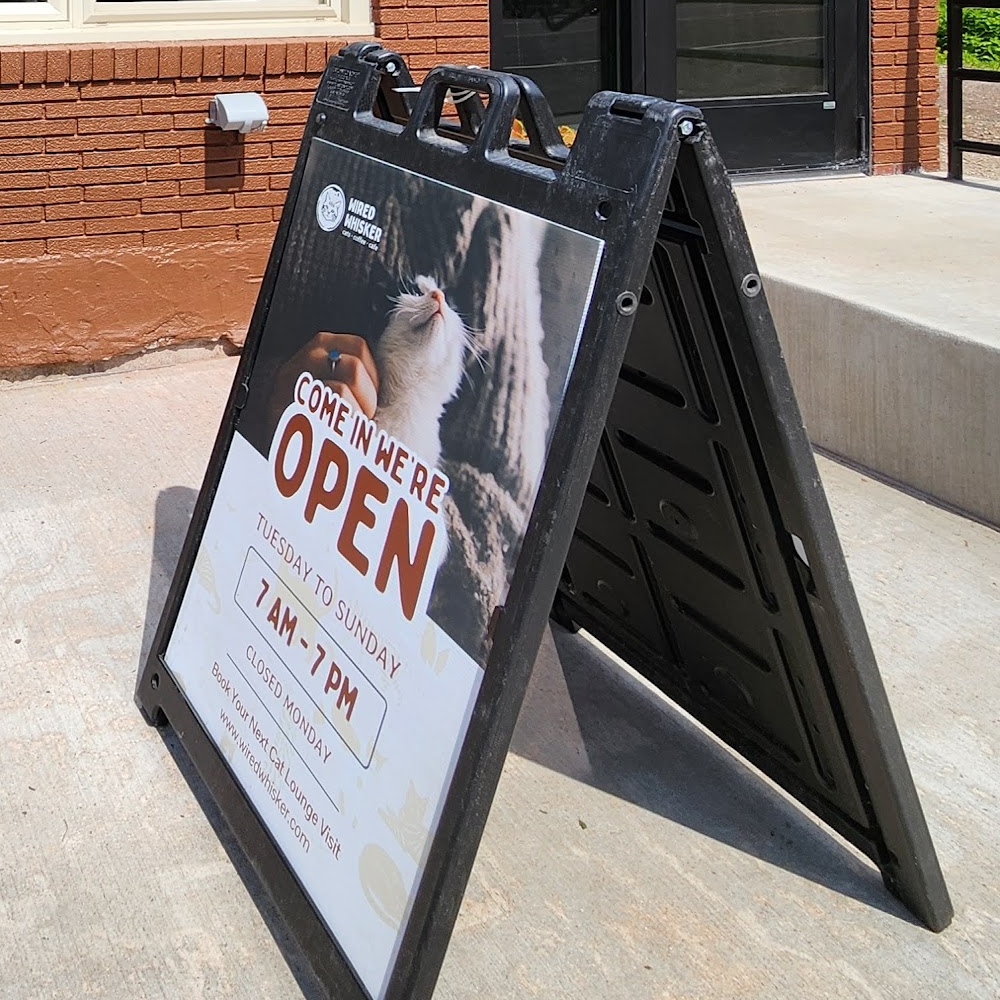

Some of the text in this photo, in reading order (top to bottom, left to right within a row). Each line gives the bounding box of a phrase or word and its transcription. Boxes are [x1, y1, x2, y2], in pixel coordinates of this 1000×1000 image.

[344, 214, 382, 242] WHISKER
[348, 198, 376, 220] WIRED
[274, 413, 436, 621] OPEN
[297, 376, 445, 514] COME IN WE'RE
[256, 512, 401, 679] TUESDAY TO SUNDAY
[256, 578, 270, 608] 7
[267, 597, 298, 646] AM
[311, 643, 326, 676] 7
[324, 661, 358, 722] PM
[211, 662, 341, 860] Book Your Next Cat Lounge Visit
[246, 645, 332, 764] CLOSED MONDAY
[220, 709, 310, 853] www.wiredwhisker.com
